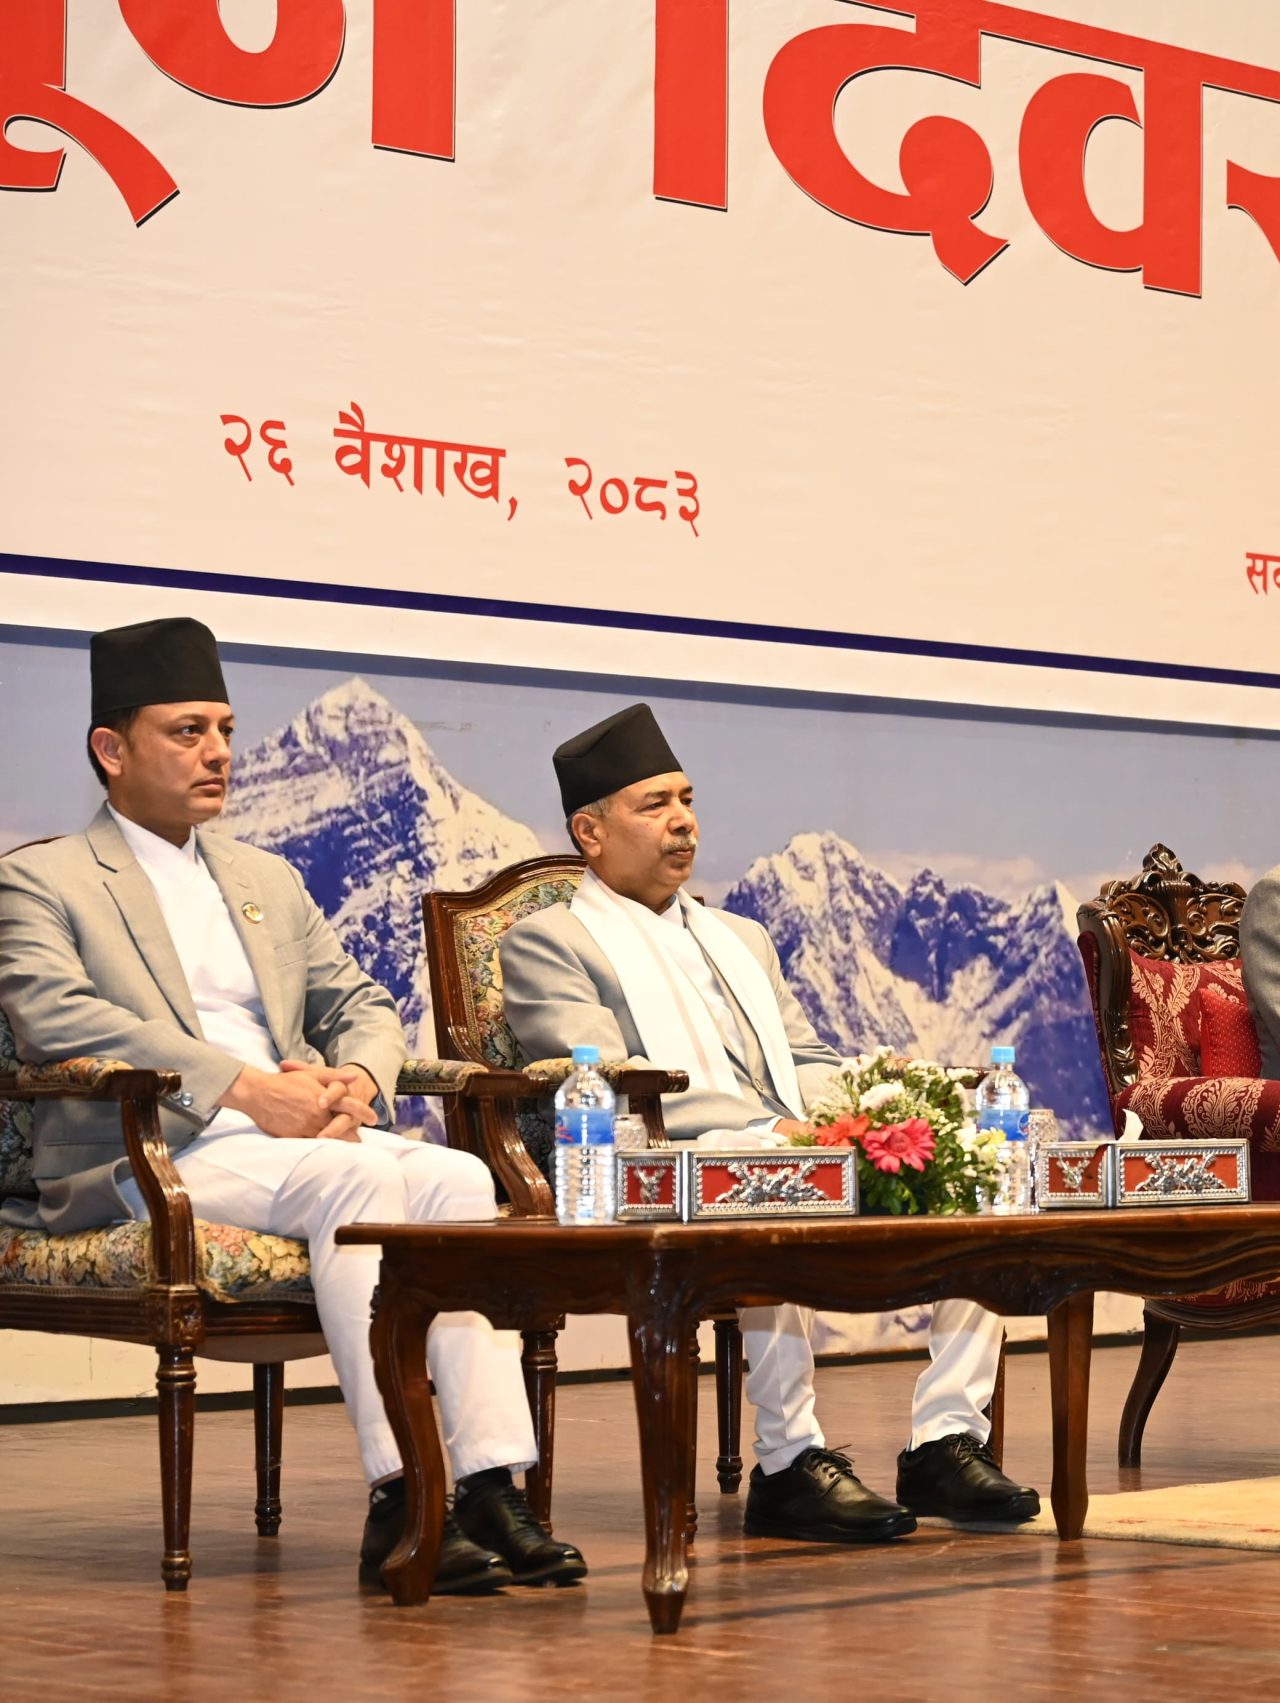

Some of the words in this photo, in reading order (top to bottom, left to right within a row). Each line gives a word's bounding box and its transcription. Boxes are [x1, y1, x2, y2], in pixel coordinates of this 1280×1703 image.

[219, 413, 295, 487] २६
[332, 401, 520, 522] वैशाख,
[563, 456, 701, 538] २०८३
